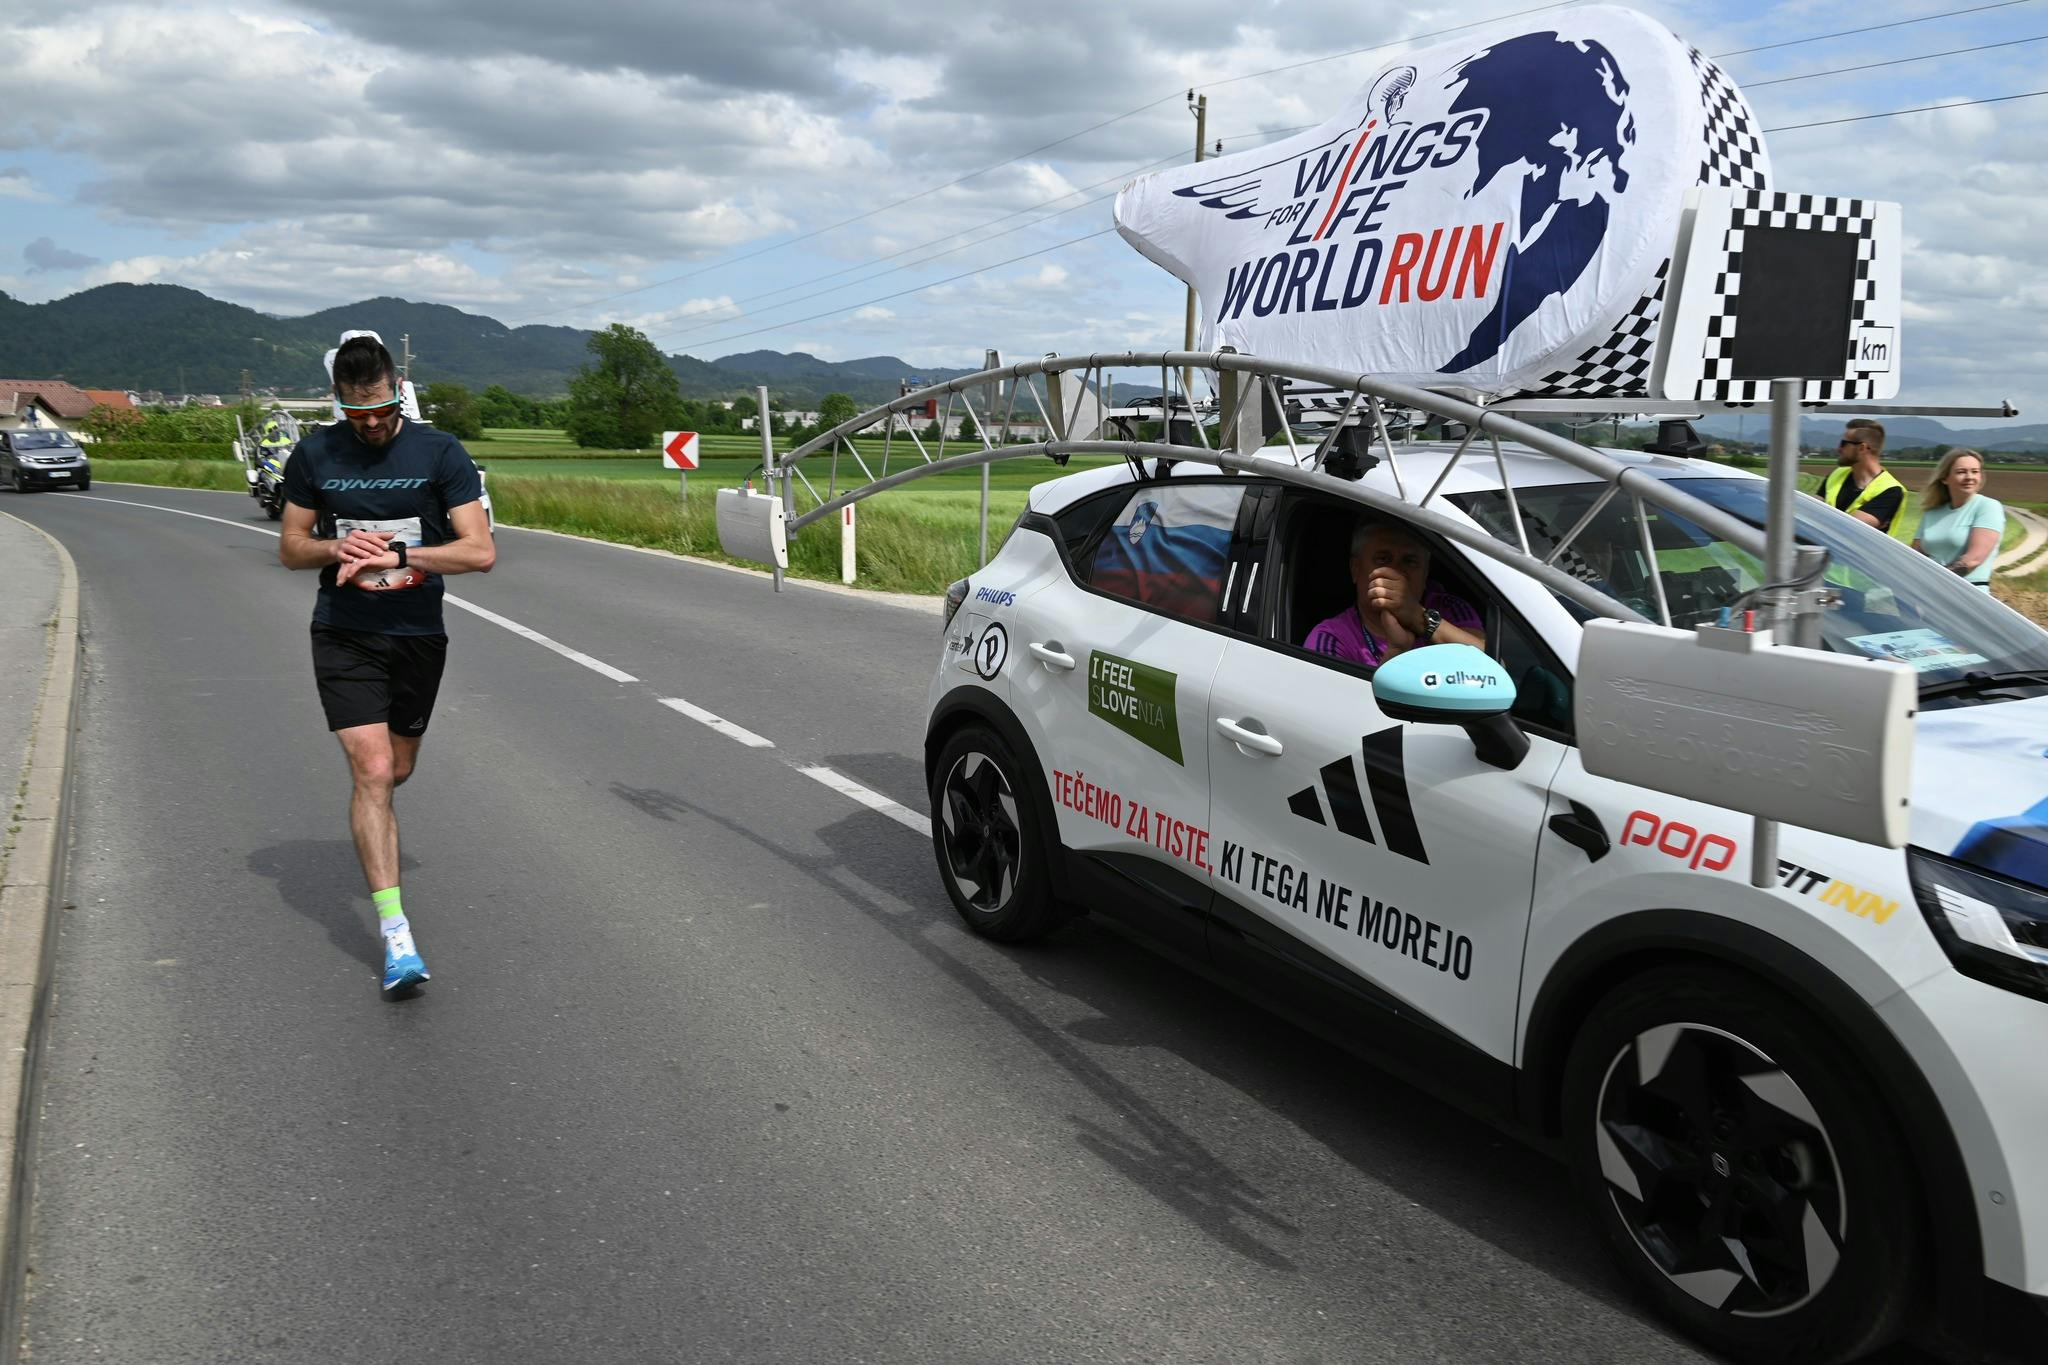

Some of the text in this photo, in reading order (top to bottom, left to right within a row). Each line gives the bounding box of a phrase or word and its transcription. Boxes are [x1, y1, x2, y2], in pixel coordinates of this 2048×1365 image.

[1264, 202, 1305, 230] FOR
[1861, 336, 1887, 361] km
[321, 478, 428, 491] DYNAFIT
[405, 575, 414, 585] 2
[975, 587, 1017, 607] PHILIPS
[1091, 657, 1136, 692] I FEEL
[1445, 671, 1497, 689] allwyn
[1619, 810, 1738, 872] pop
[1053, 770, 1473, 981] TEČEMO ZA TISTE, KI TEGA NE MOREJO
